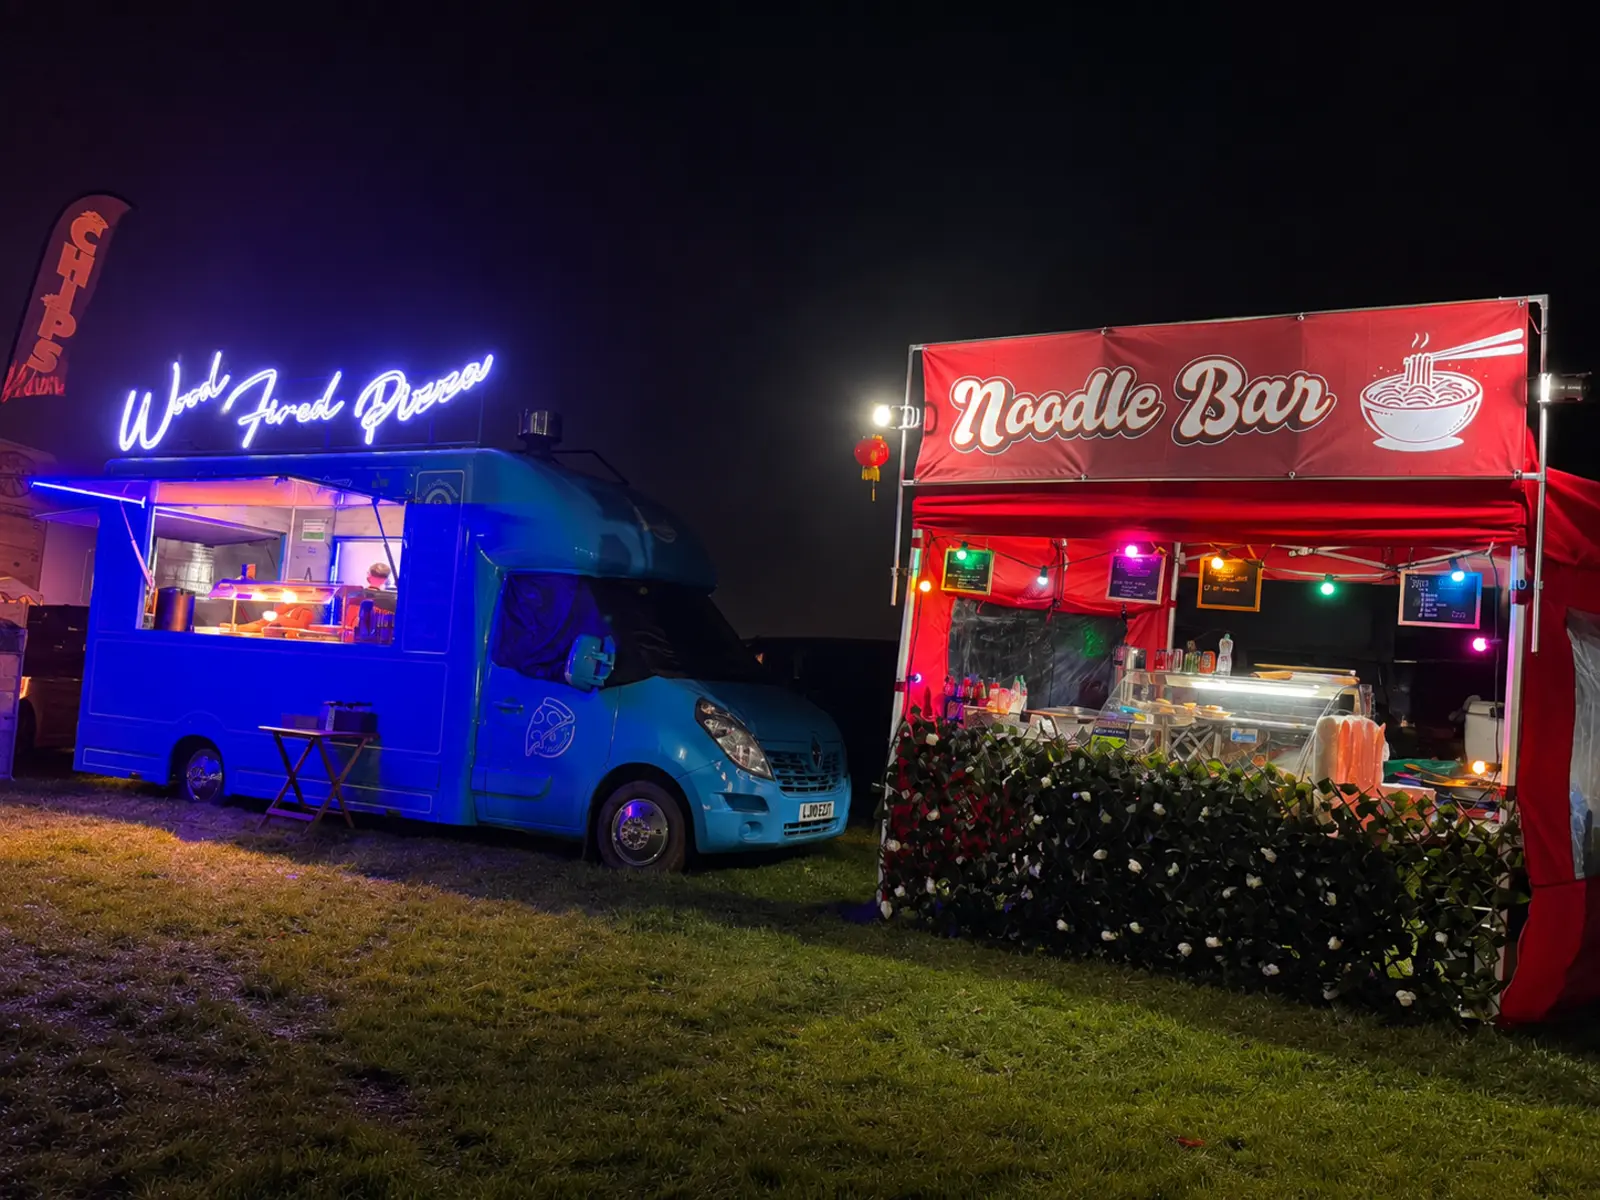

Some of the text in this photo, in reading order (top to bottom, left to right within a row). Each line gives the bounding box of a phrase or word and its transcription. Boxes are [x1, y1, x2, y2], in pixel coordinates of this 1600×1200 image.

[27, 210, 109, 373] CHIPS
[119, 350, 230, 451] Wood
[221, 368, 345, 448] Fired
[354, 354, 494, 446] Pizza
[951, 355, 1336, 454] Noodle Bar
